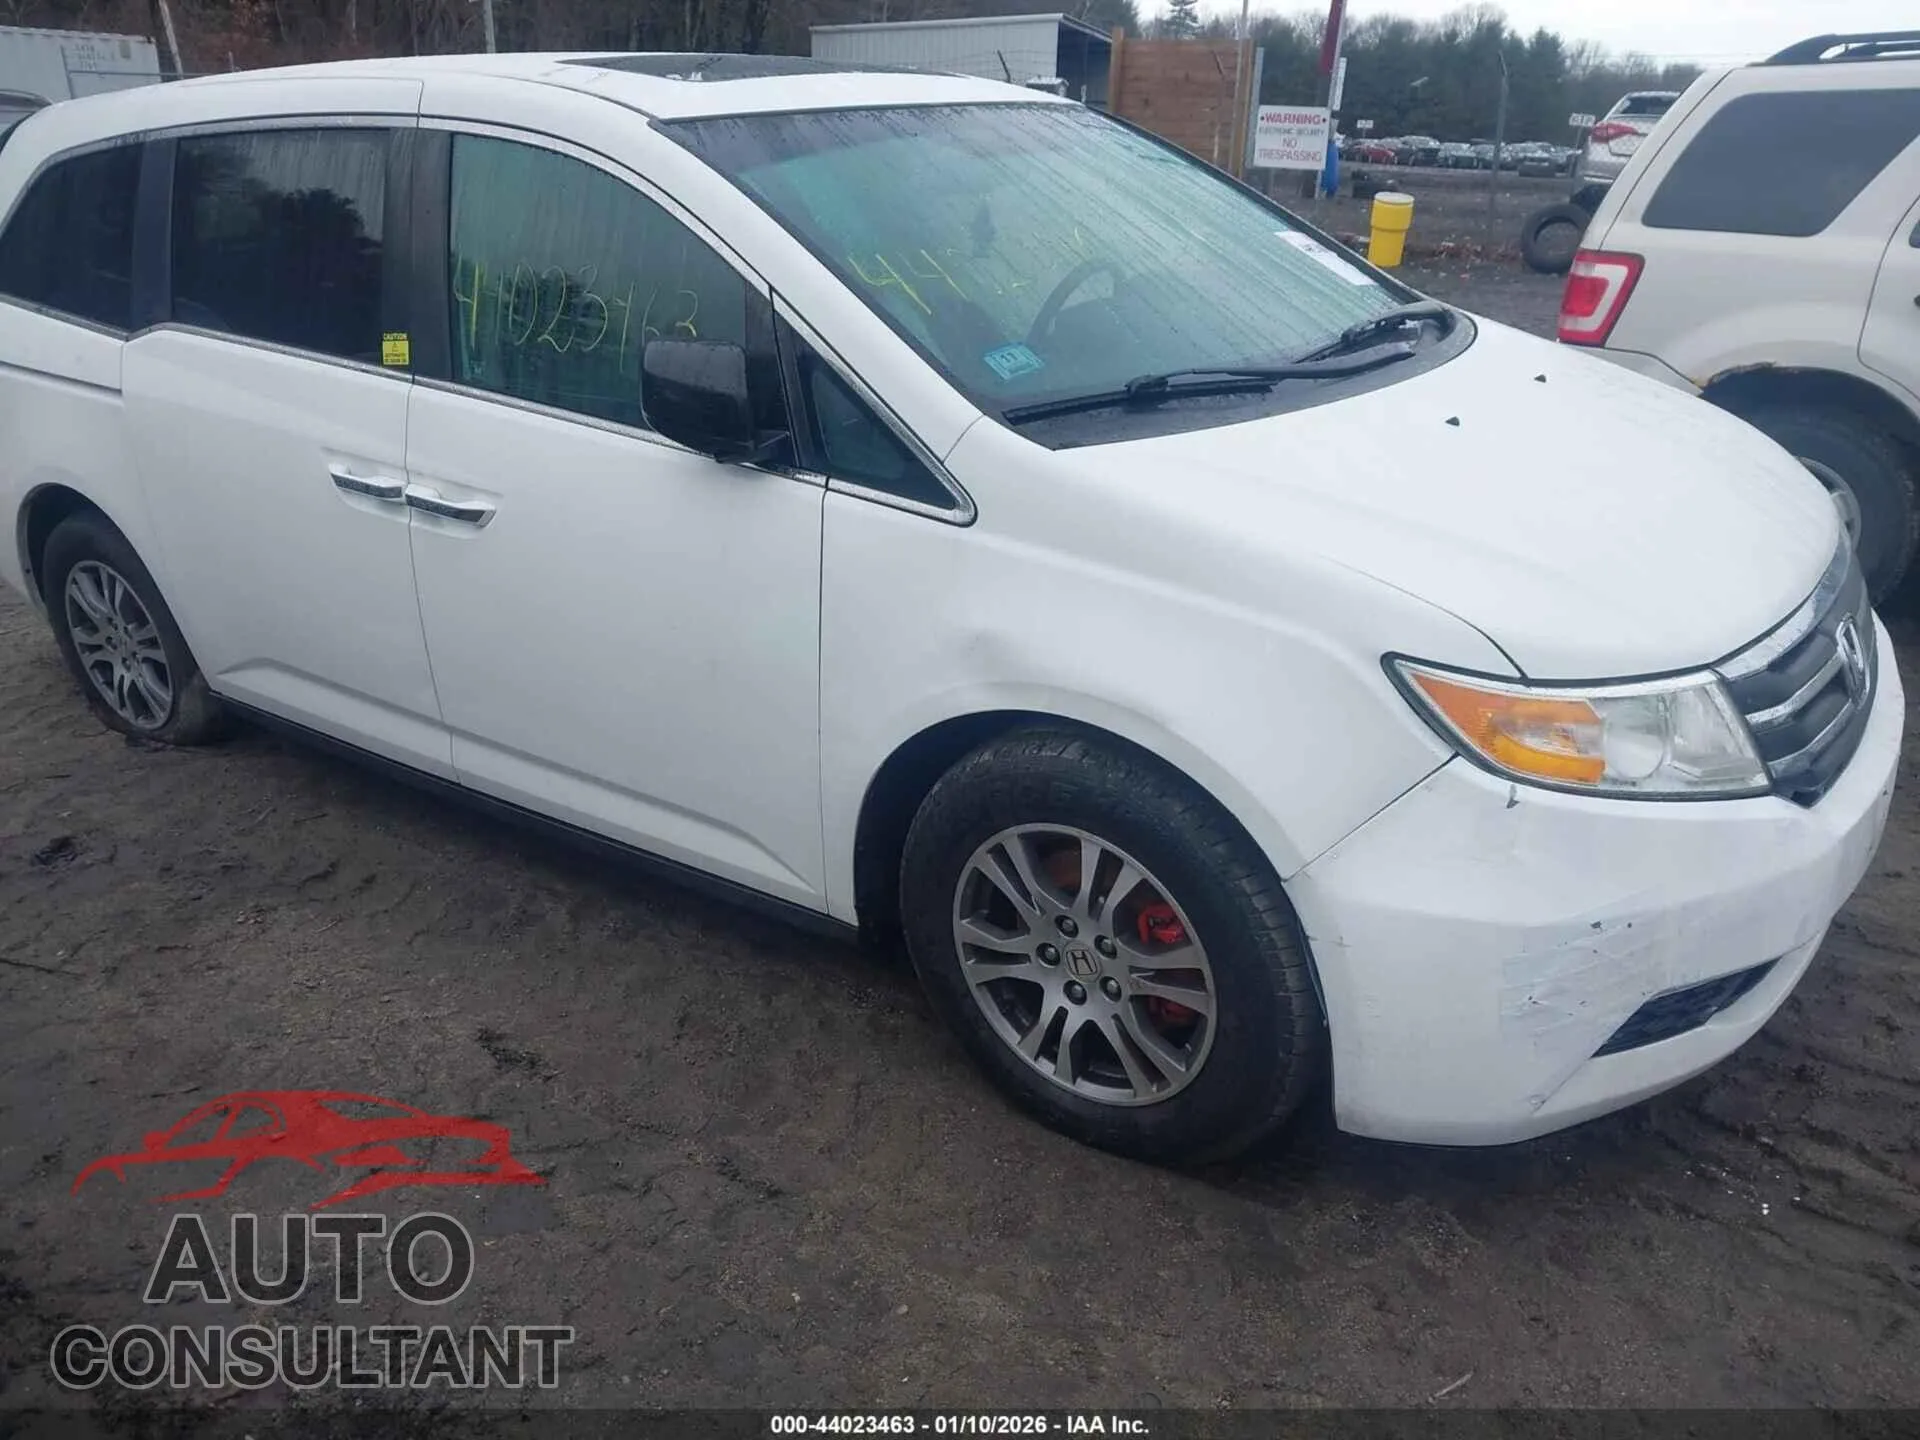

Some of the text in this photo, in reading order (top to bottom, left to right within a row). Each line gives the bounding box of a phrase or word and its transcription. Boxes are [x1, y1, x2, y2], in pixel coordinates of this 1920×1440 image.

[1263, 112, 1321, 125] WARNING
[1282, 136, 1298, 148] NO
[1258, 149, 1321, 161] TRESPASSING
